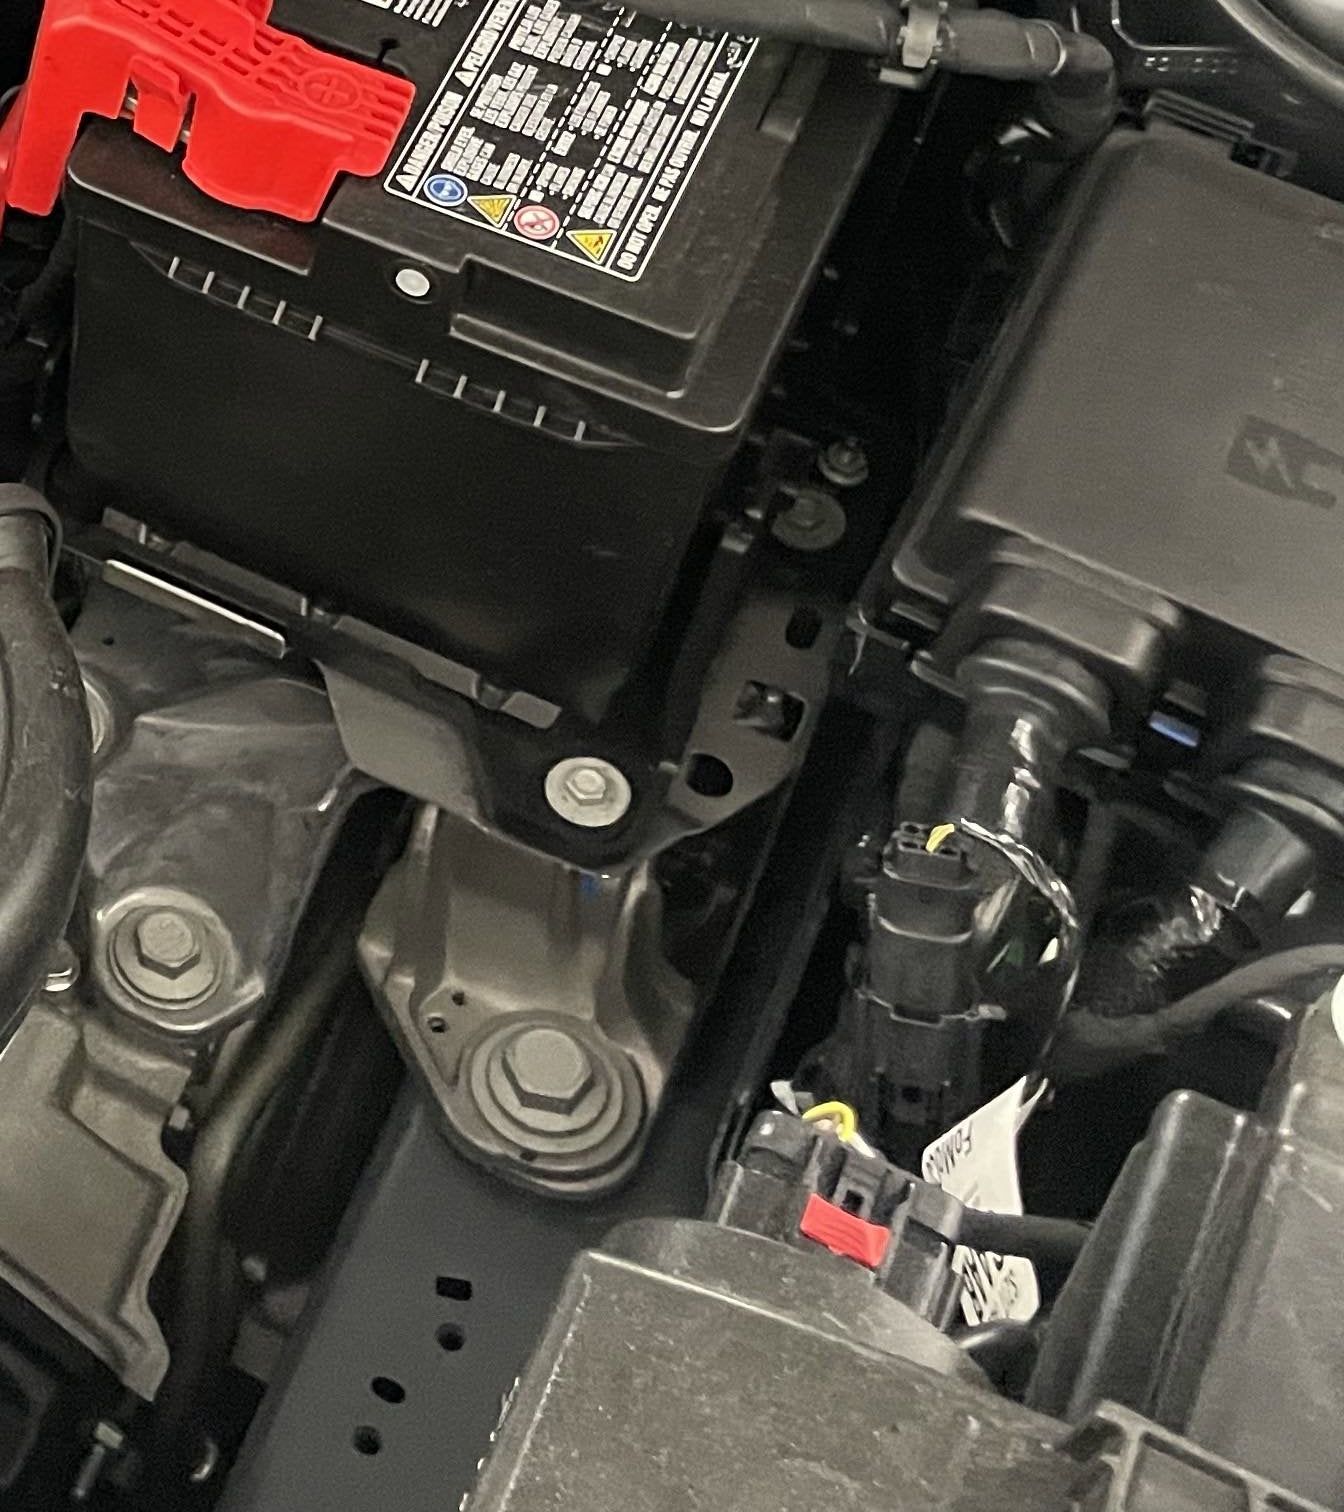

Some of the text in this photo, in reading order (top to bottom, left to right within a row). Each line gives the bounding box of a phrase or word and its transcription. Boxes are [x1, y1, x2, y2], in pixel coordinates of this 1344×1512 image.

[697, 97, 716, 112] LA
[658, 167, 680, 188] PAS
[652, 185, 671, 202] NE
[625, 230, 647, 254] NOT
[617, 252, 637, 270] DO
